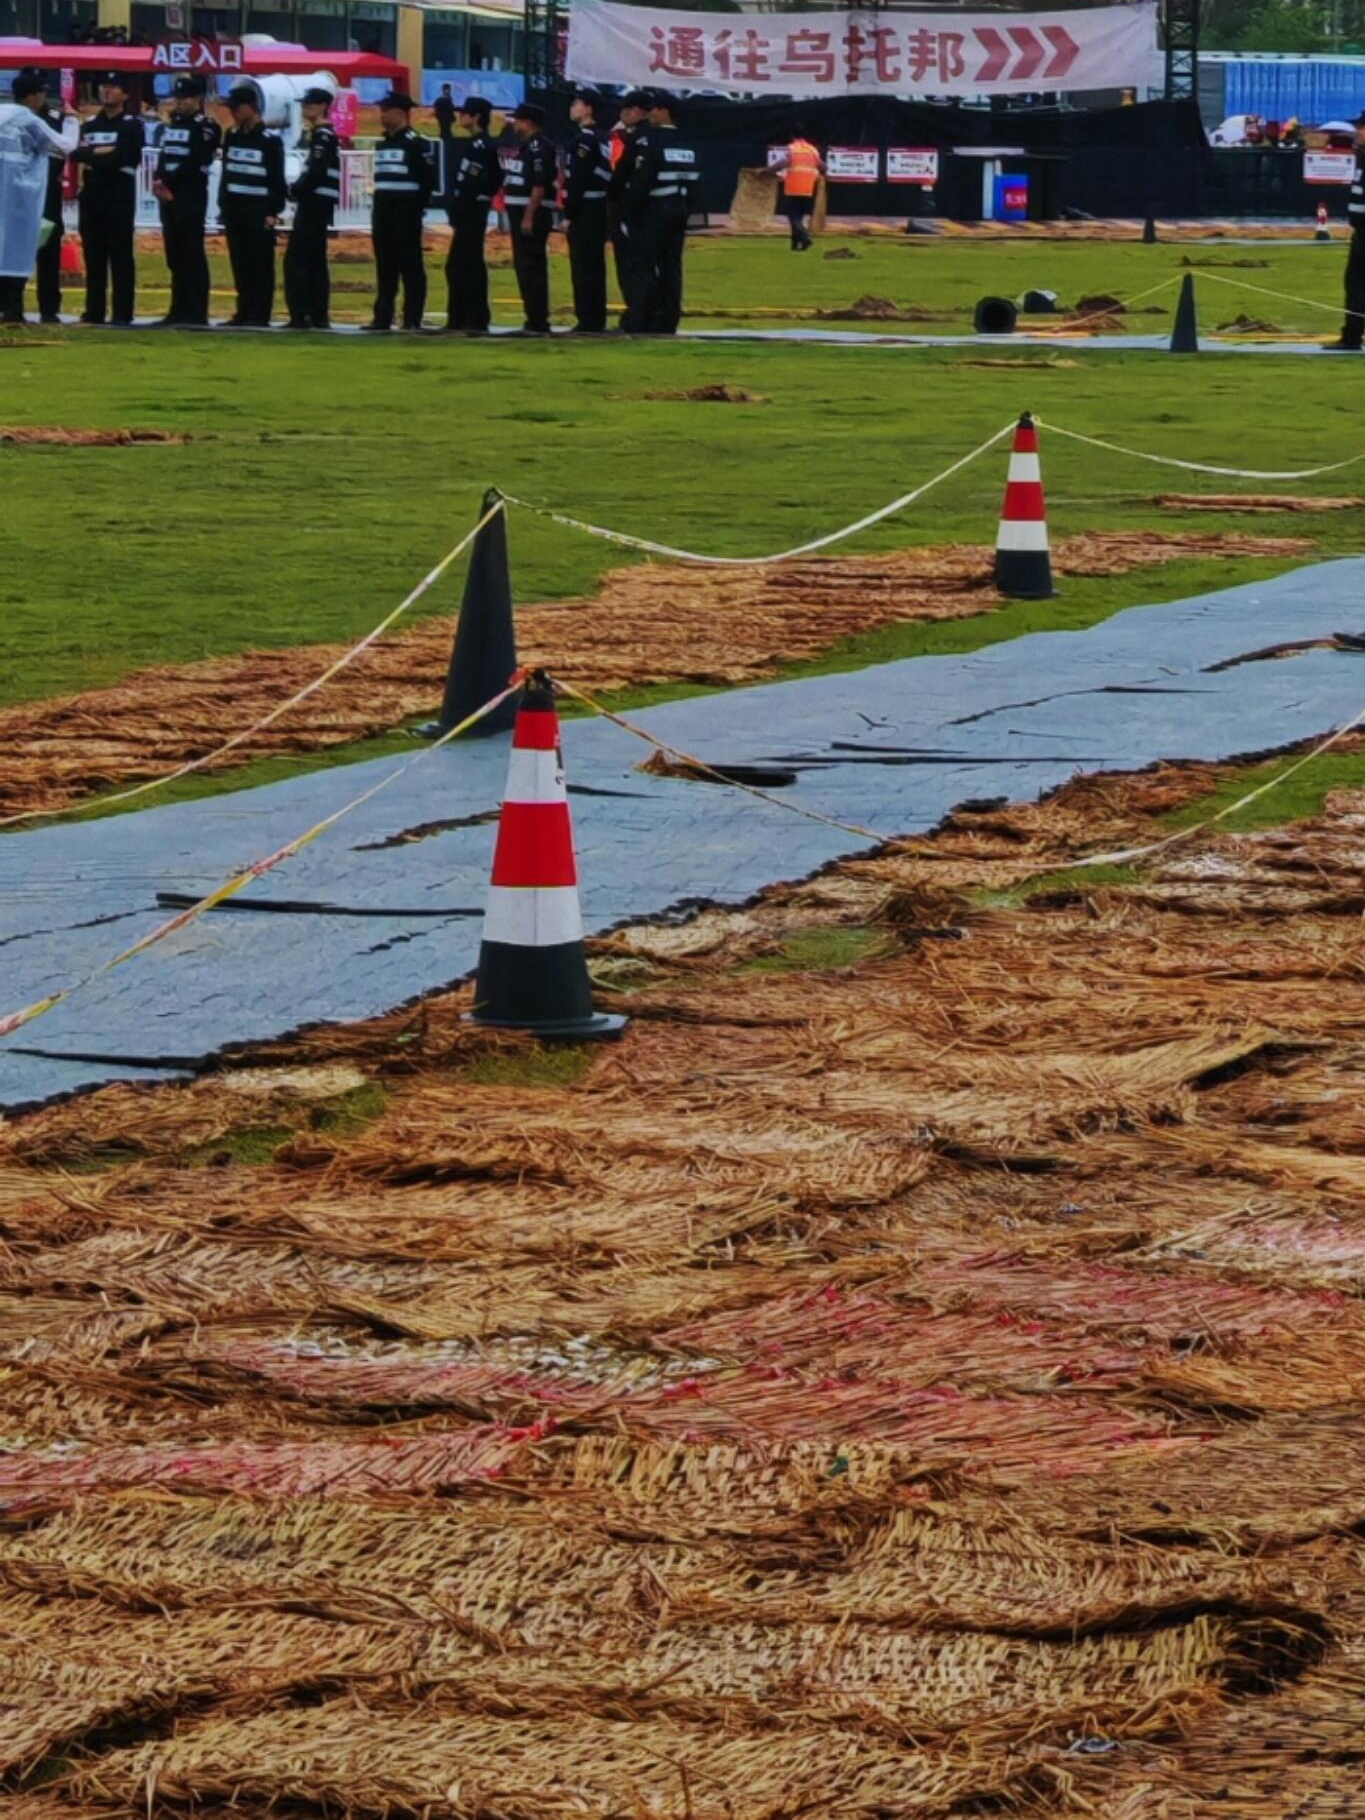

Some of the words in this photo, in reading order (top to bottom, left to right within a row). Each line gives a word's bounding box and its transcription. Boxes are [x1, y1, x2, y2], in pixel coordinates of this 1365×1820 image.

[153, 42, 242, 69] A区入口
[648, 24, 966, 84] 通往乌托邦
